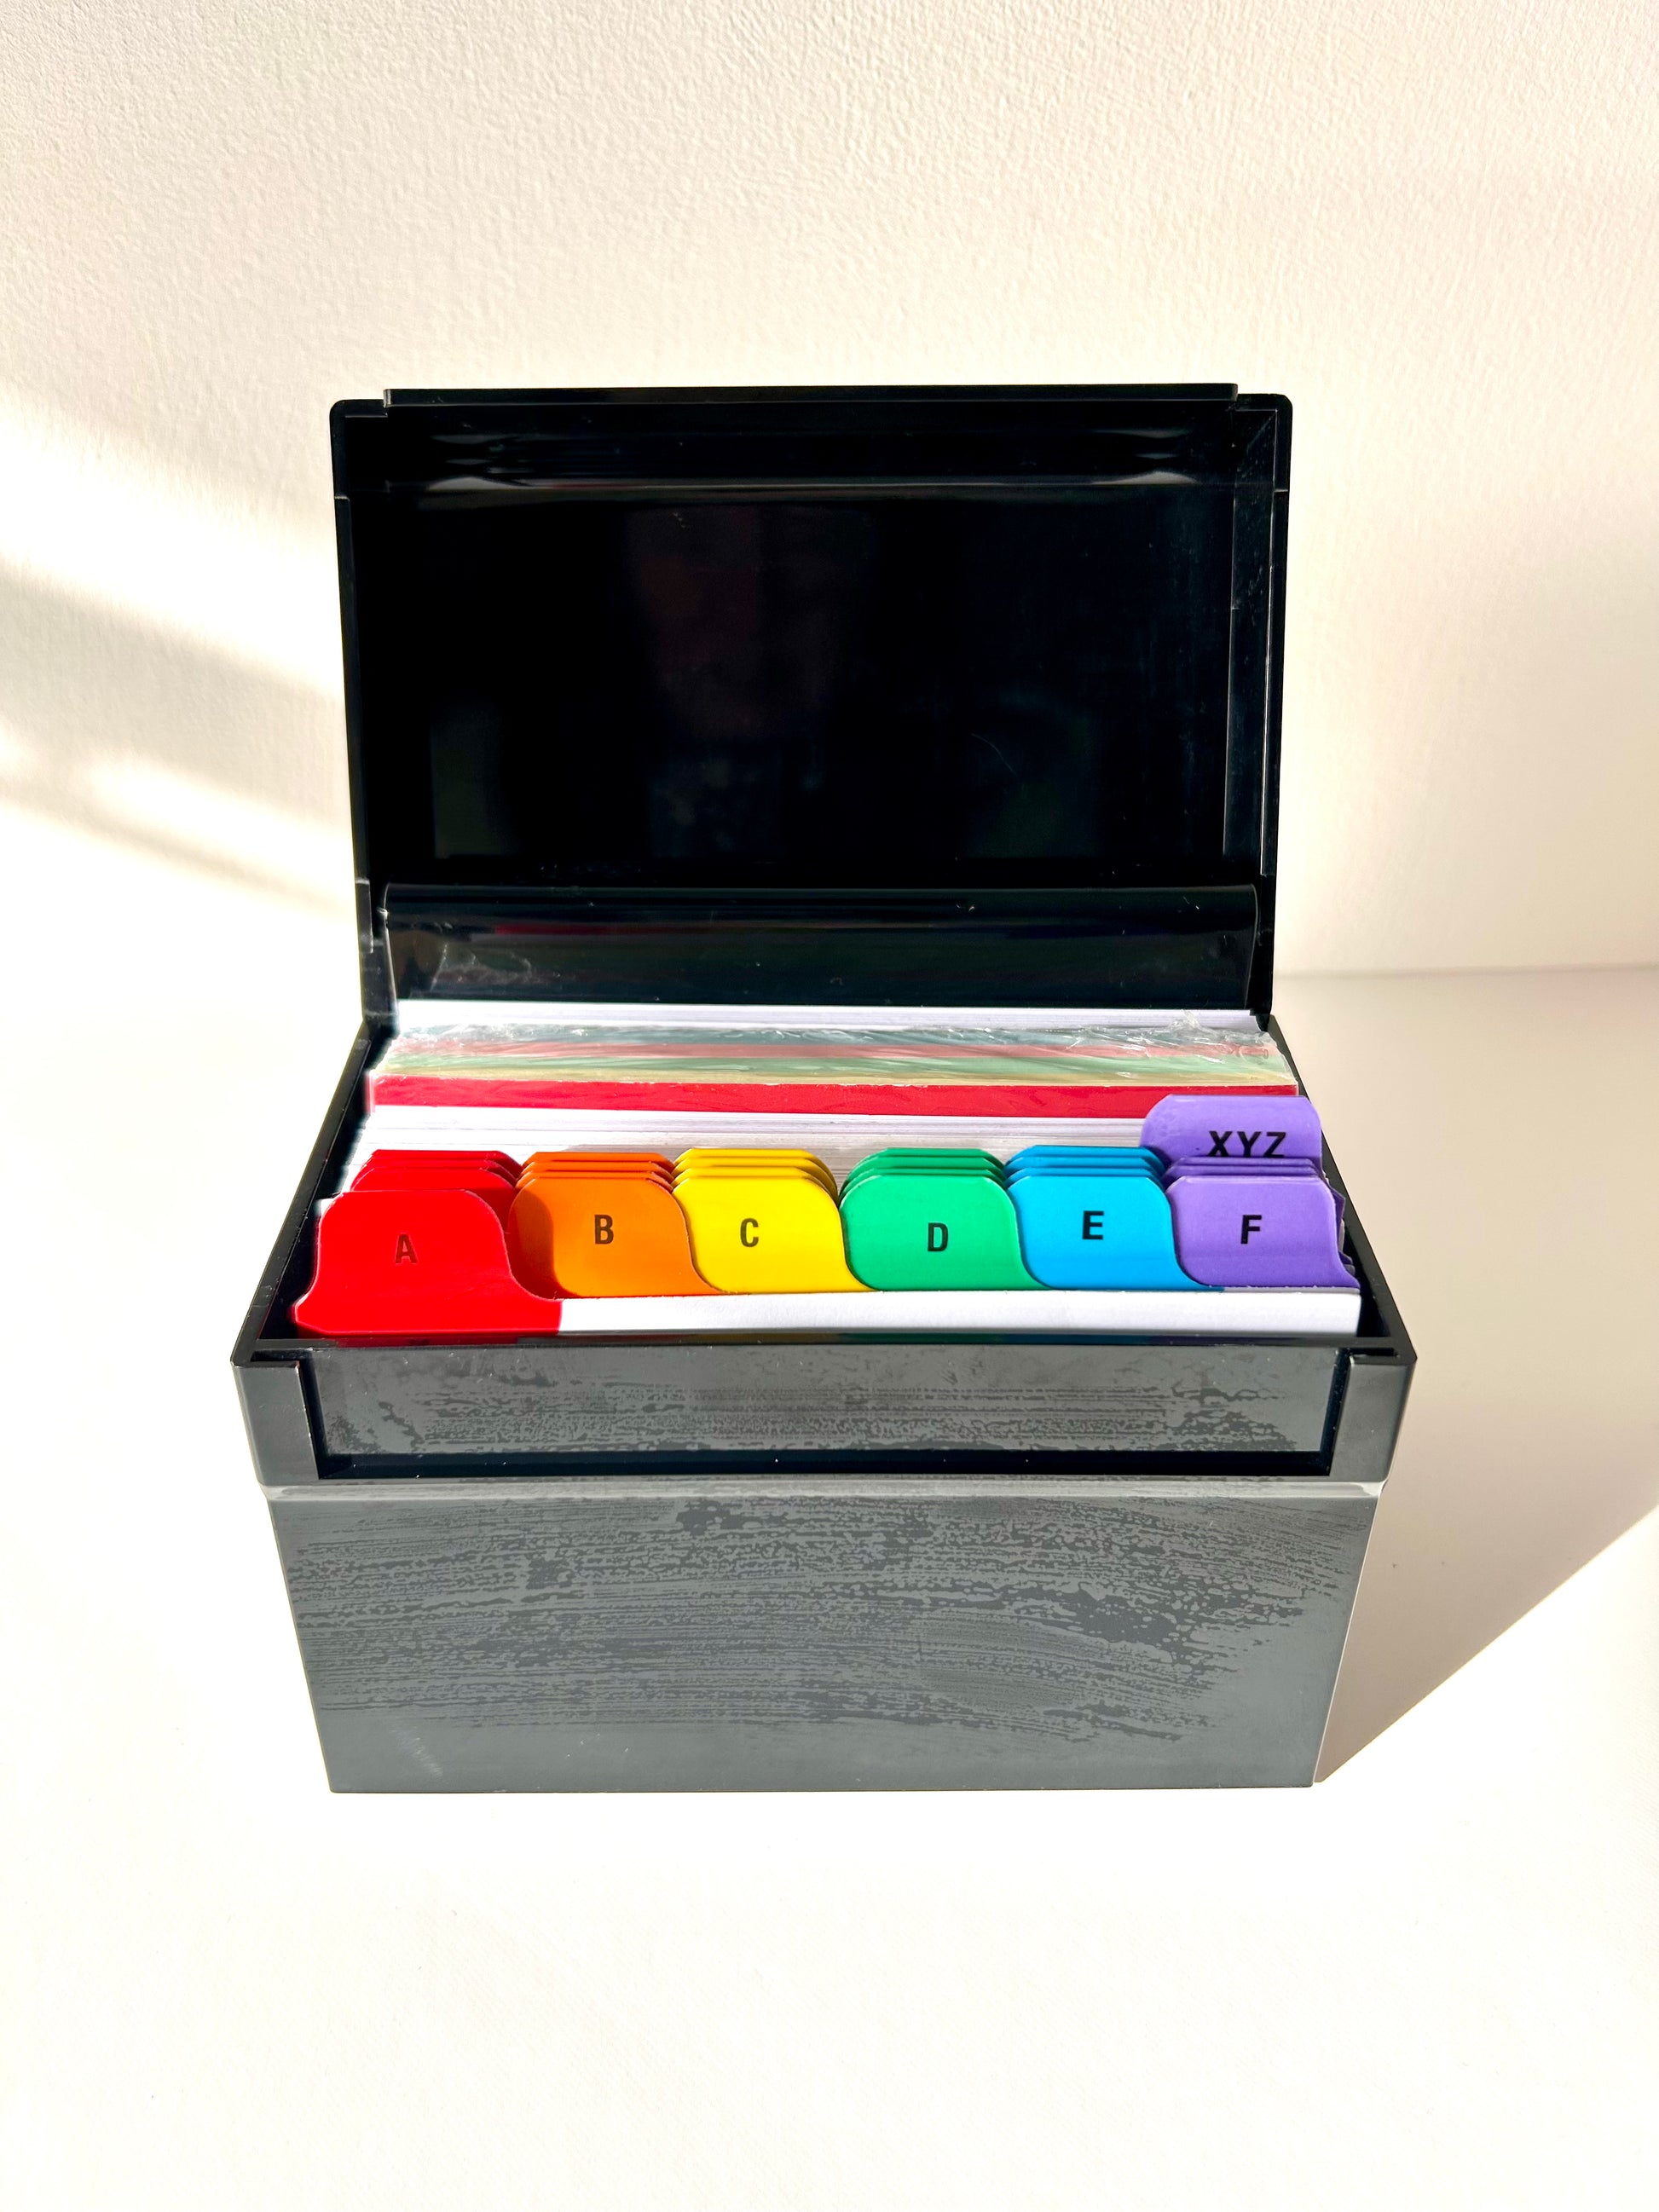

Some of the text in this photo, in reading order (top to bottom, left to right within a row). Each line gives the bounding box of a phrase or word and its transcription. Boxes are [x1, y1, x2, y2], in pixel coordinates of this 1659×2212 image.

[1207, 1130, 1286, 1158] XYZ
[594, 1215, 614, 1244] B
[740, 1218, 760, 1247] C
[928, 1222, 949, 1252] D
[1082, 1210, 1104, 1240] E
[1241, 1215, 1263, 1245] F
[395, 1234, 417, 1263] A
